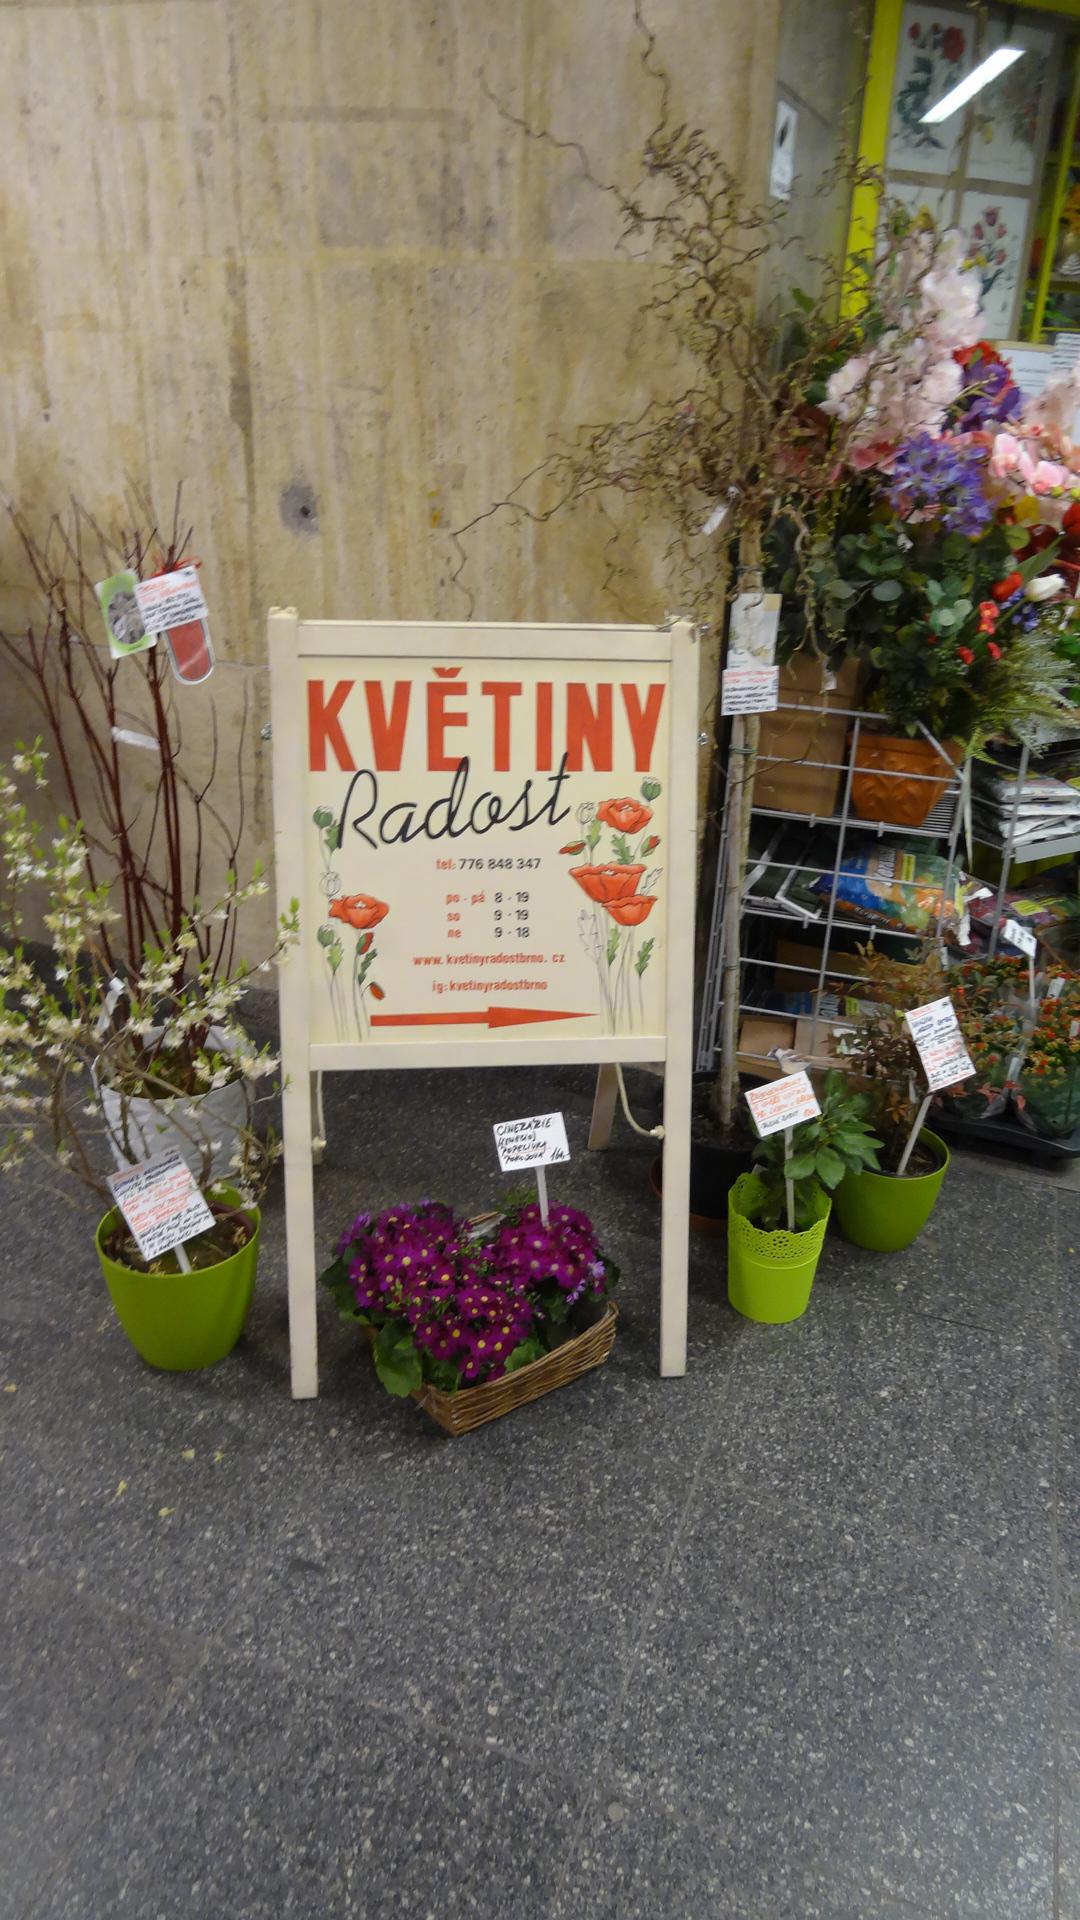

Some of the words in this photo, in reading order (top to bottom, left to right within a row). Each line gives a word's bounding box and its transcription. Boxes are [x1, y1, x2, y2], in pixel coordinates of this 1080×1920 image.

[306, 667, 666, 772] KVĚTINY
[337, 752, 571, 849] Radost
[436, 858, 455, 870] tel:
[458, 858, 484, 870] 776
[487, 858, 513, 870] 848
[516, 858, 541, 870] 347
[446, 893, 460, 905] po
[494, 891, 503, 903] 8
[515, 891, 529, 903] 19
[447, 912, 461, 922] so
[494, 909, 502, 921] 9
[515, 909, 529, 921] 19
[447, 928, 462, 938] ne
[494, 926, 503, 938] 9
[515, 926, 530, 938] 18
